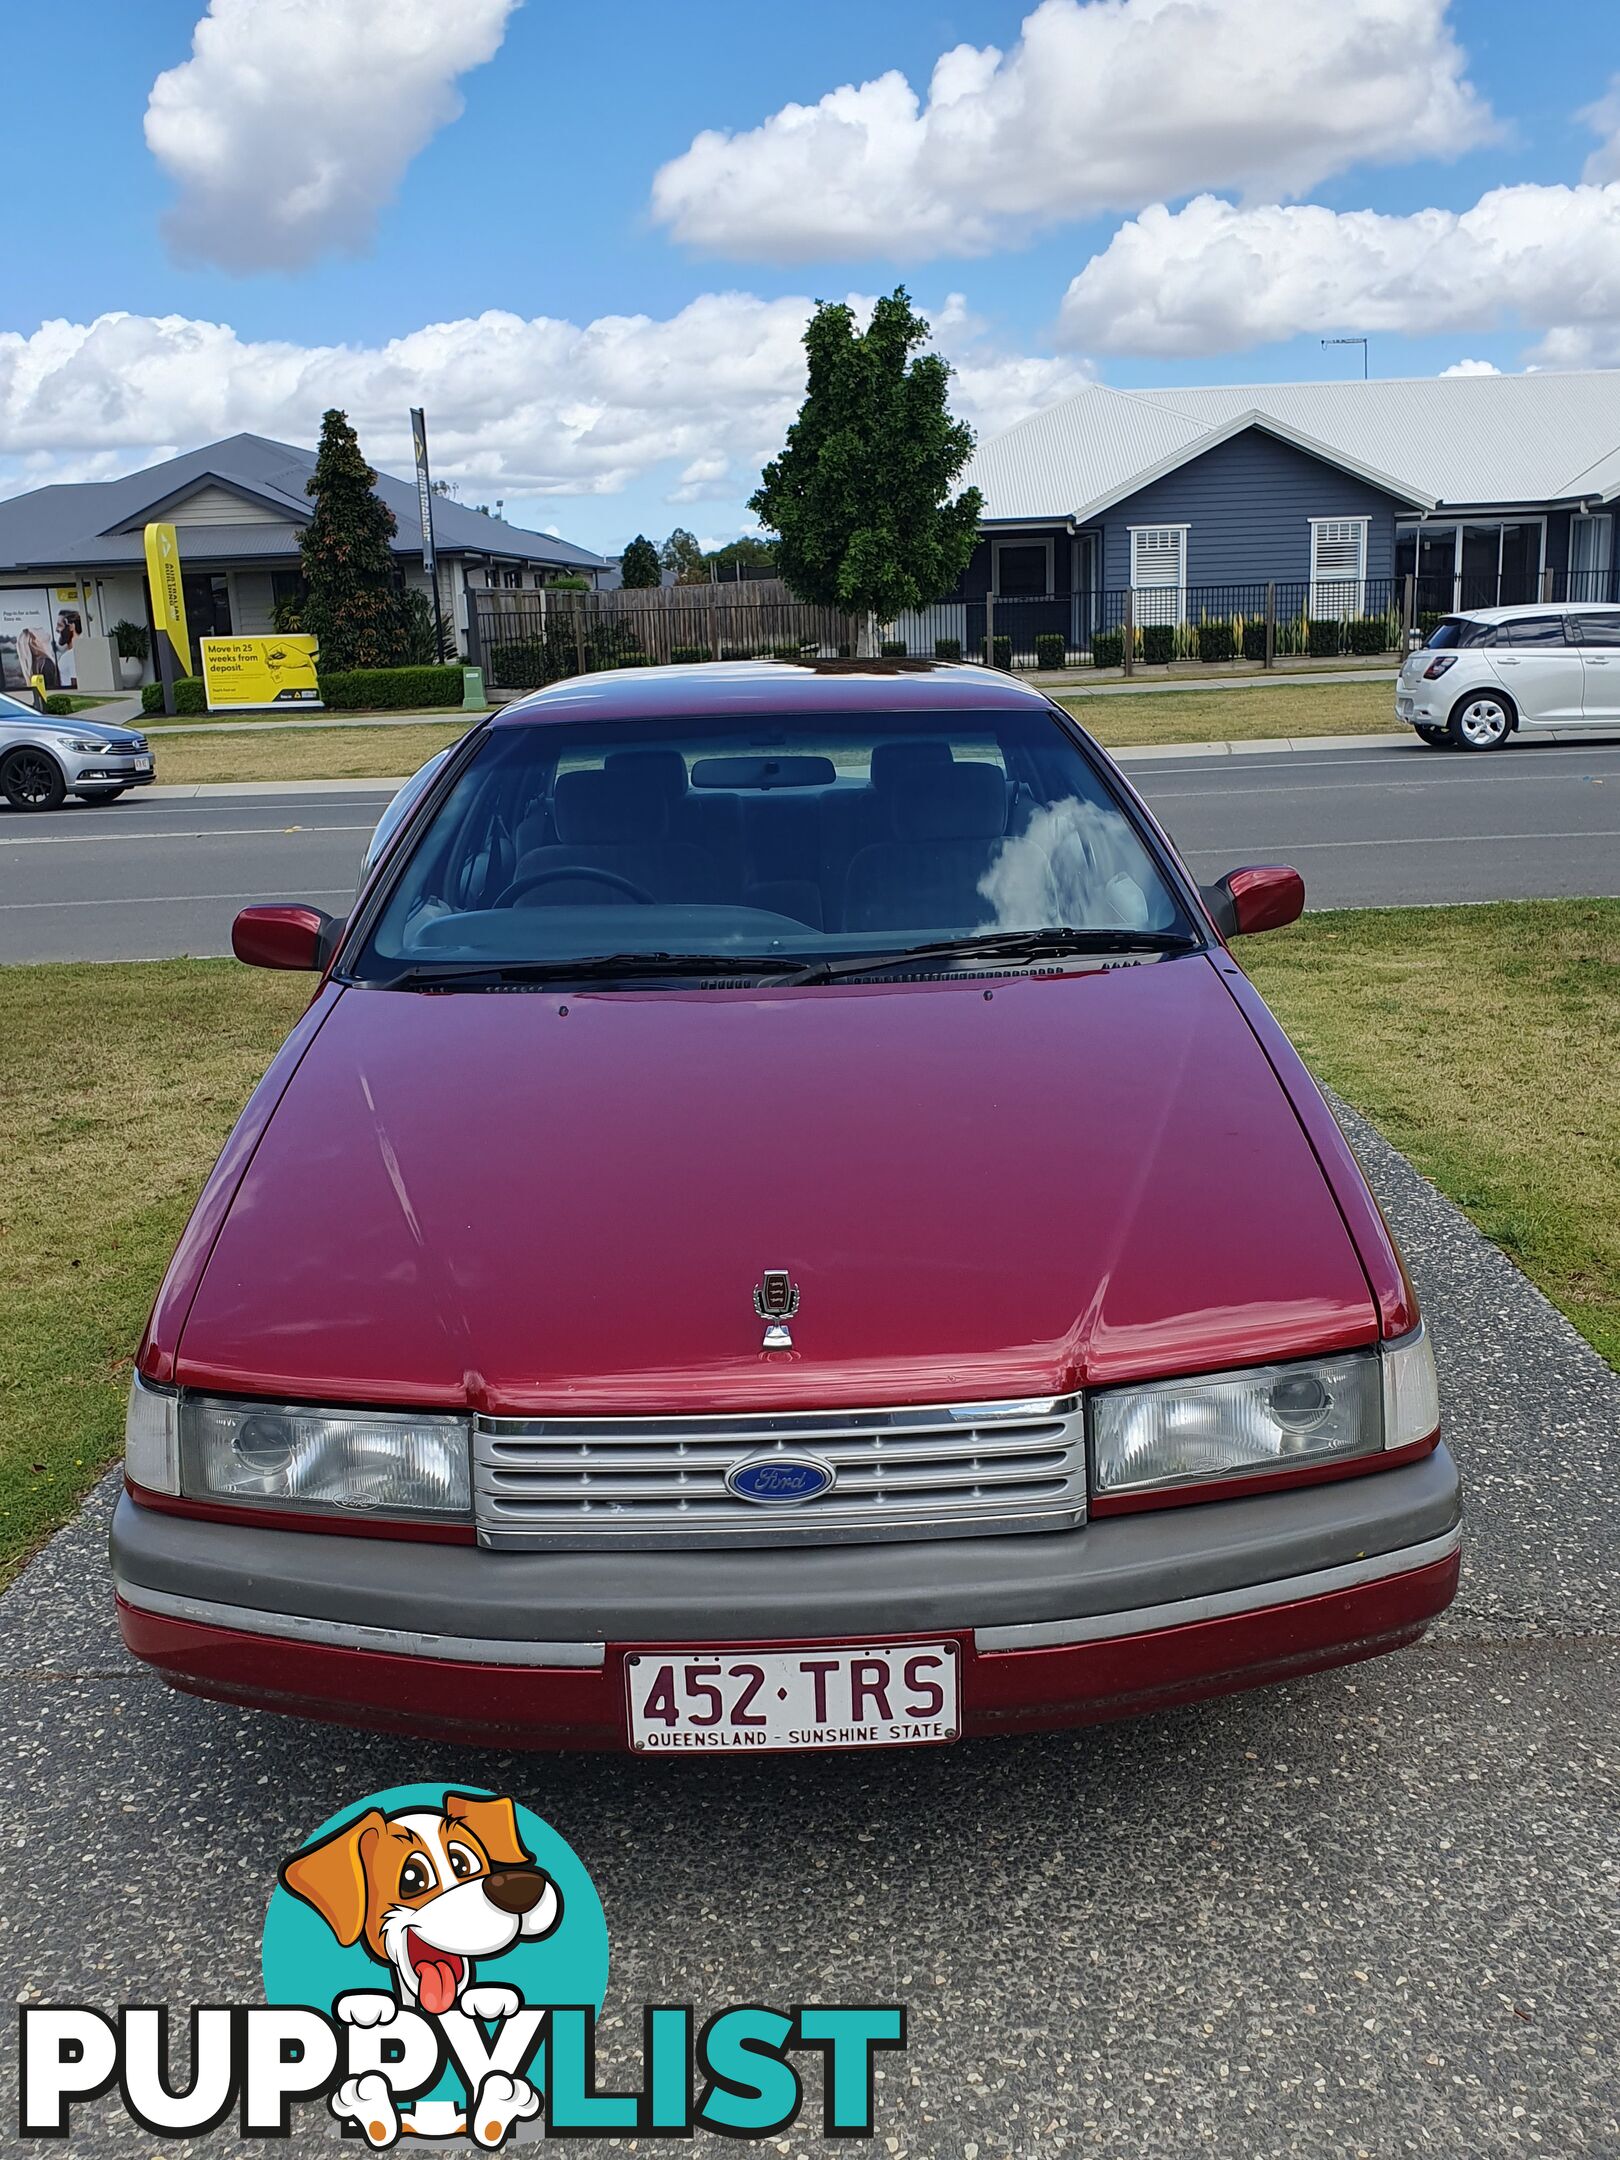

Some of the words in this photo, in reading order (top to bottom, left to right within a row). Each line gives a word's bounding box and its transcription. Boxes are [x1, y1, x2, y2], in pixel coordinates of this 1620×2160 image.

[169, 563, 180, 622] AUSTRALIAN
[208, 645, 233, 653] Move
[233, 644, 241, 652] in
[242, 644, 253, 652] 25
[209, 654, 236, 662] weeks
[238, 654, 258, 662] from
[210, 664, 244, 672] deposit.
[754, 1467, 806, 1490] Ford
[649, 1732, 767, 1747] QUEENSLAND
[789, 1727, 879, 1743] SUNSHINE
[889, 1722, 943, 1738] STATE
